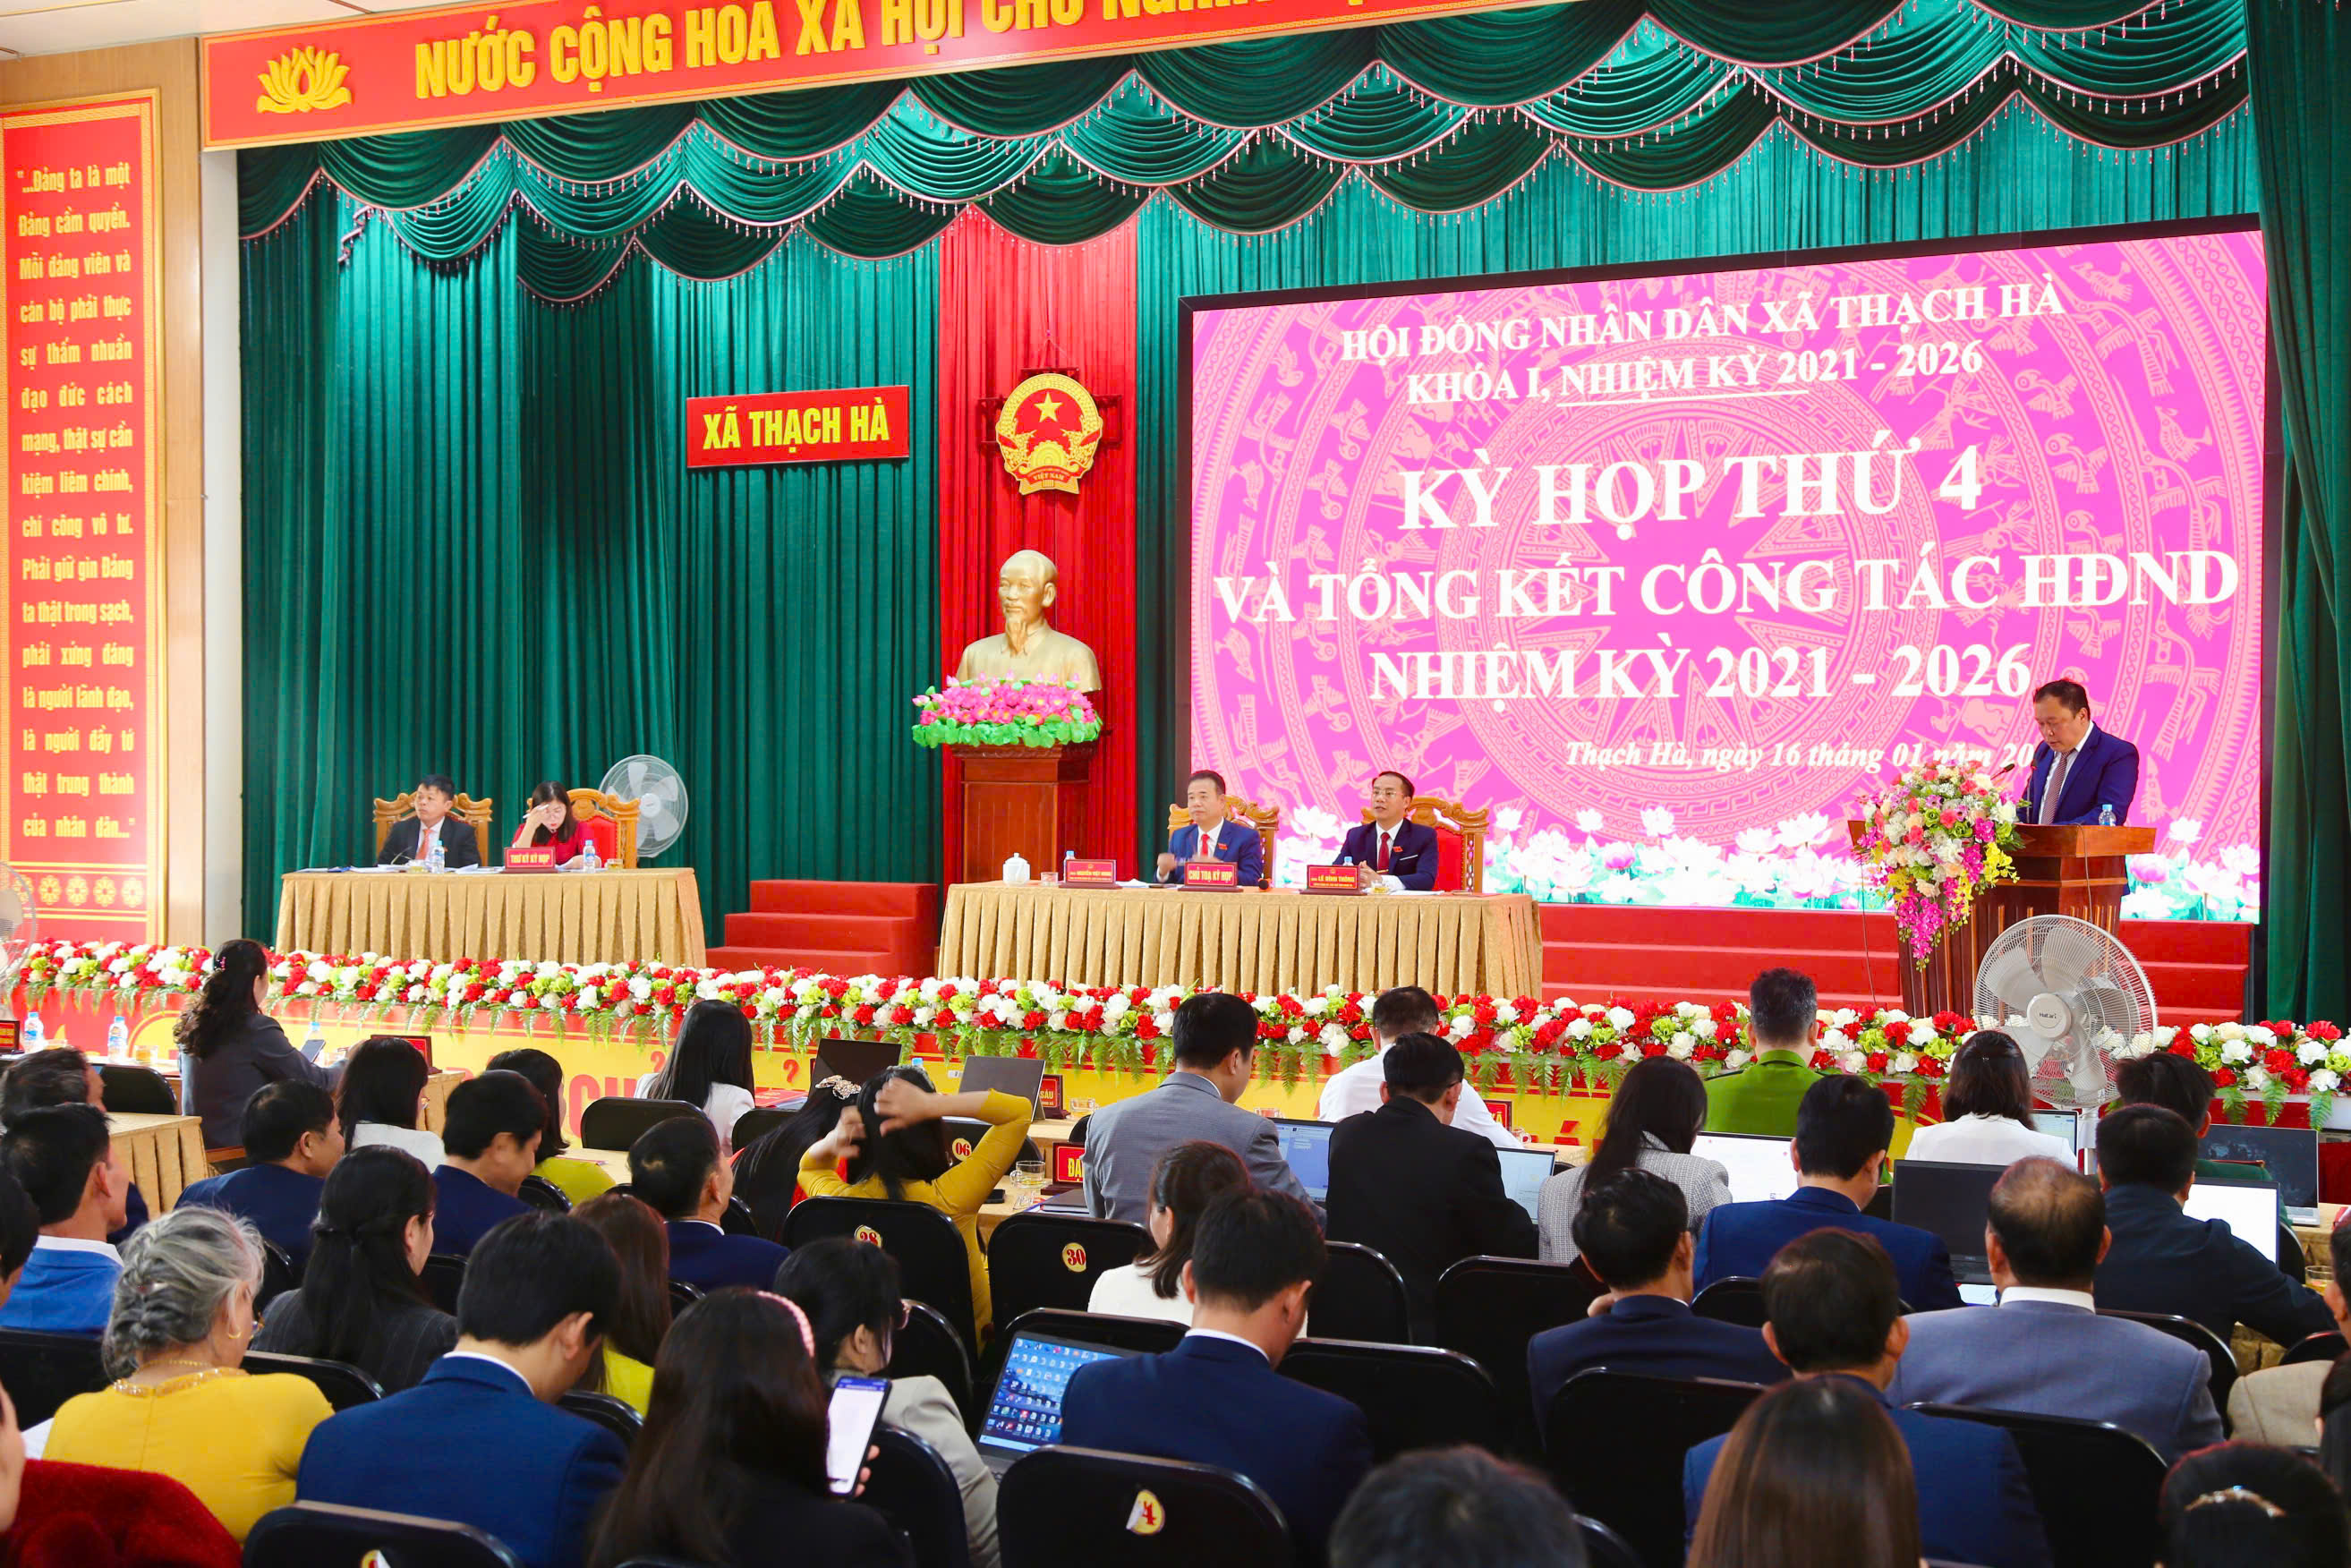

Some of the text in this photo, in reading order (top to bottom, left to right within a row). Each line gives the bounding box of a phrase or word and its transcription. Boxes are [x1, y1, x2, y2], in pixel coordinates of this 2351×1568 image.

[415, 14, 535, 100] NƯỚC
[549, 5, 673, 93] CỘNG
[70, 167, 82, 189] ta
[87, 165, 101, 187] là
[105, 161, 130, 190] một
[18, 201, 131, 237] Đảng cầm quyền.
[19, 249, 132, 279] Mỗi đảng viên và
[20, 294, 132, 326] cán bộ phải thực
[1341, 271, 2067, 367] HỘI ĐỒNG NHÂN DÂN XÃ THẠCH HÀ
[21, 333, 132, 371] sự thấm nhuần
[1407, 338, 1984, 405] KHÓA I, NHIỆM KỲ 2021 - 2026
[21, 380, 133, 413] đạo đức cách
[21, 420, 133, 456] mạng, thật sự cần
[702, 396, 891, 454] XÃ THẠCH HÀ
[21, 468, 133, 499] kiệm liêm chính,
[1396, 430, 1984, 541] KỲ HỌP THỨ 4
[21, 512, 133, 539] chí công vô tư.
[21, 552, 133, 583] Phải giữ gìn Đảng
[1213, 541, 2240, 624] VÀ TỔNG KẾT CÔNG TÁC HĐND
[22, 599, 134, 628] ta thật trong sạch,
[22, 640, 134, 668] phải xứng đáng
[1367, 631, 2032, 712] NHIỆM KỲ 2021 - 2026
[22, 683, 134, 713] là người lãnh đạo,
[22, 724, 134, 754] là người đầy tớ
[1564, 740, 2035, 773] Thạch Hà, ngày 16 tháng 01 năm 20
[22, 771, 134, 798] thật trung thành
[23, 812, 47, 838] của
[55, 815, 87, 838] nhân
[955, 1142, 971, 1157] 06
[1066, 1248, 1086, 1266] 30
